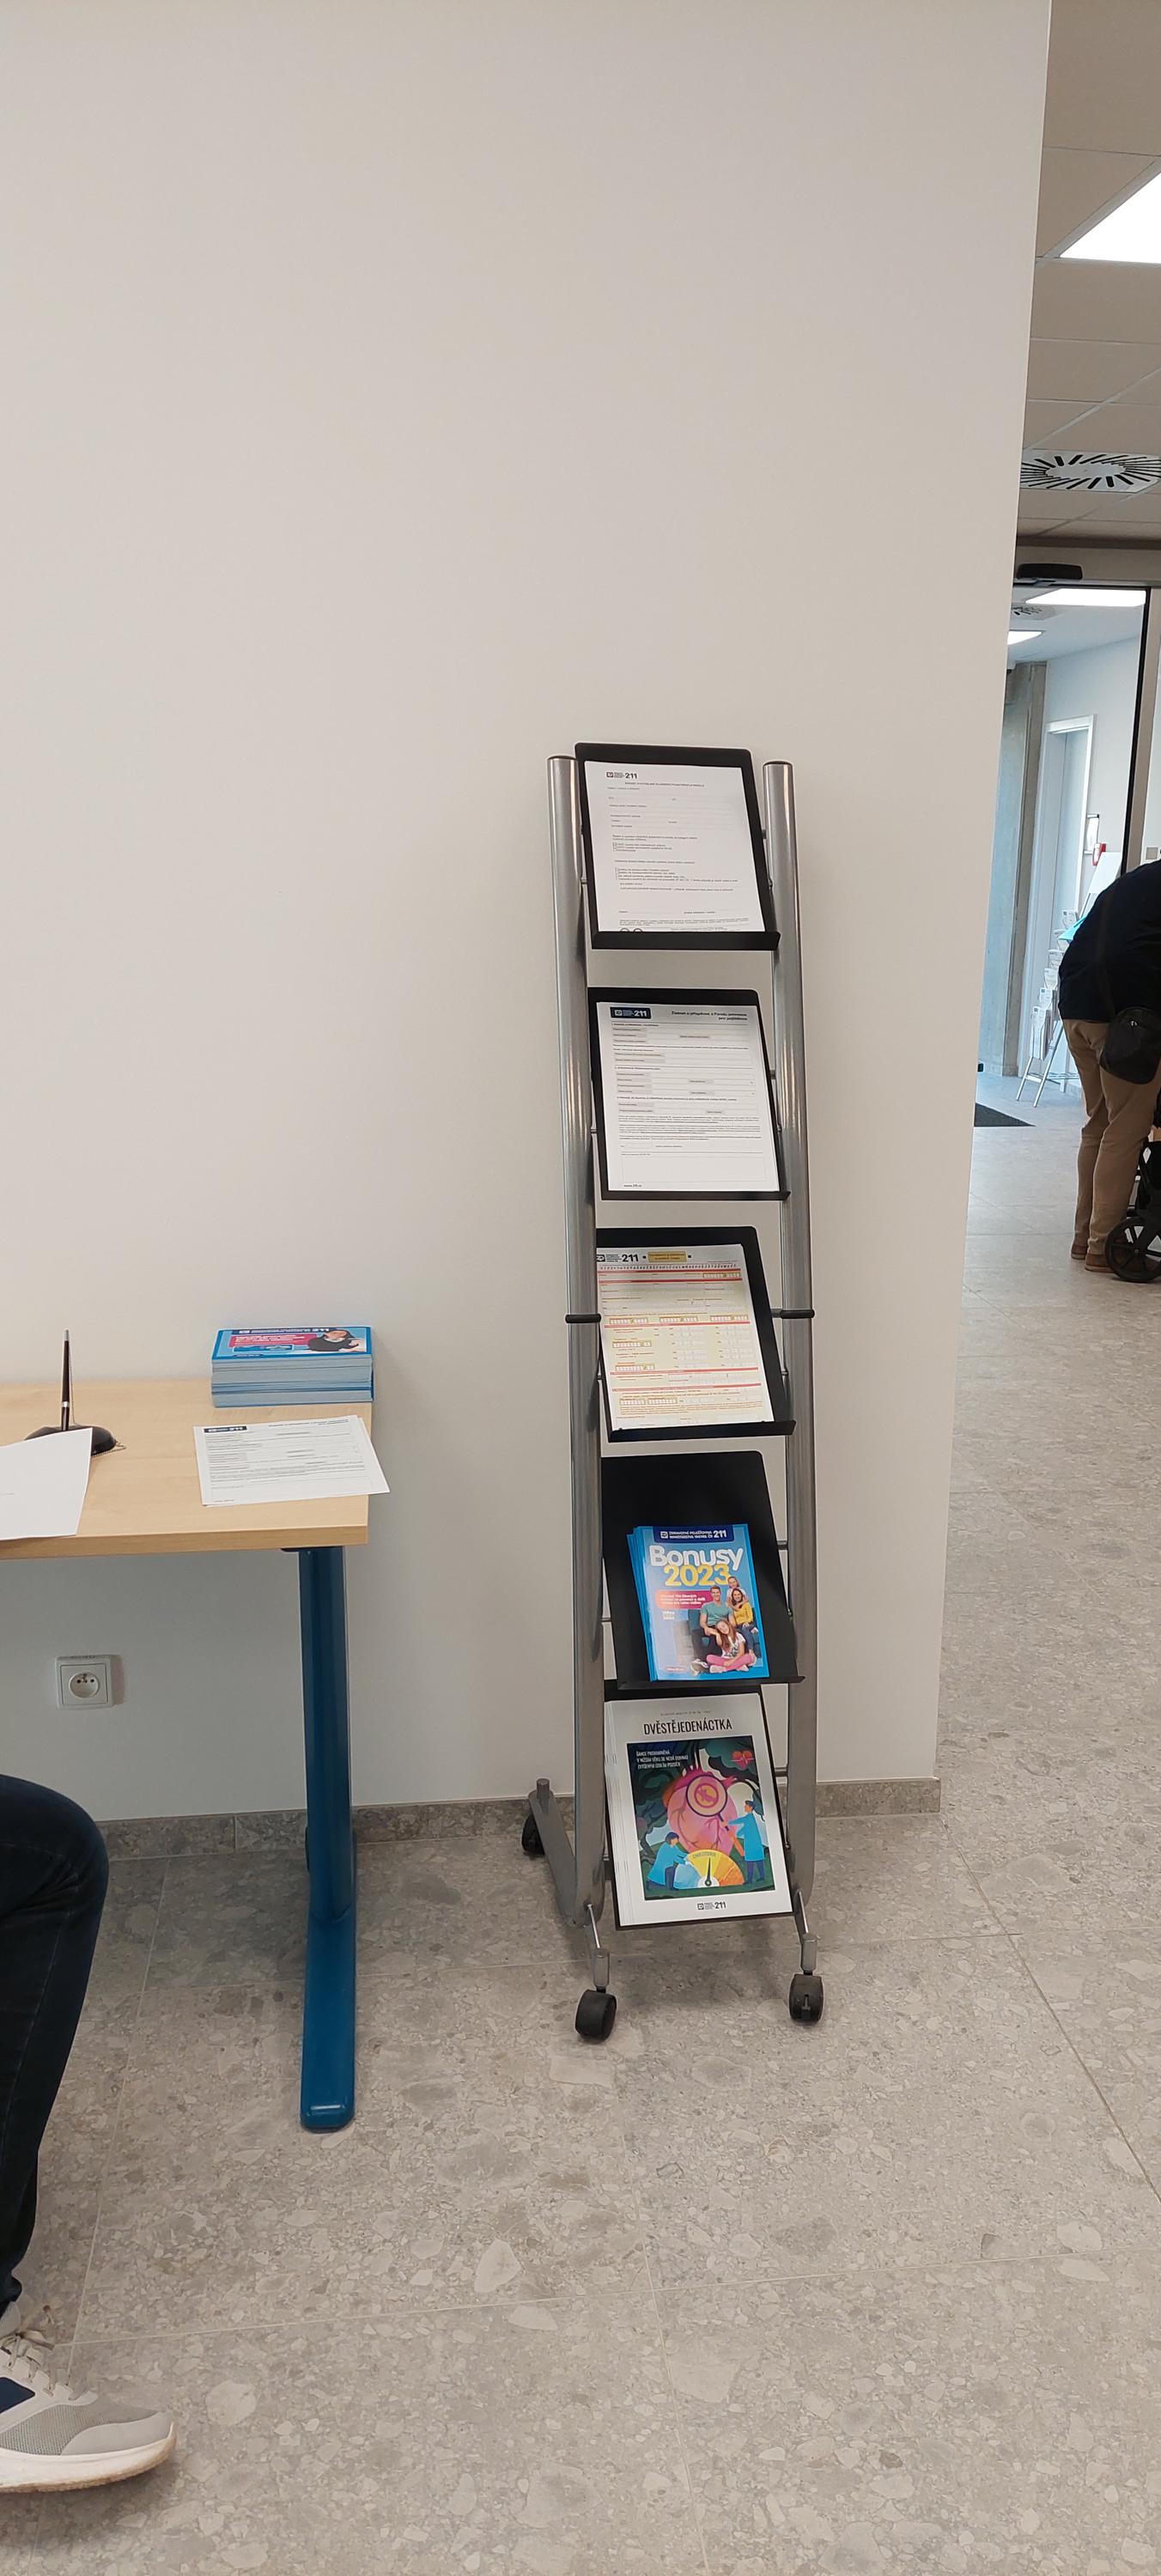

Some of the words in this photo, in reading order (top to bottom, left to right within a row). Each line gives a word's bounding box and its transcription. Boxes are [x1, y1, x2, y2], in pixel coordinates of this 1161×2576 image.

[622, 1254, 639, 1262] 211
[713, 1529, 727, 1539] 211
[649, 1545, 744, 1571] Bonusy
[664, 1564, 731, 1587] 2023
[644, 1717, 732, 1735] DVĚSTĚJEDENÁCTKA
